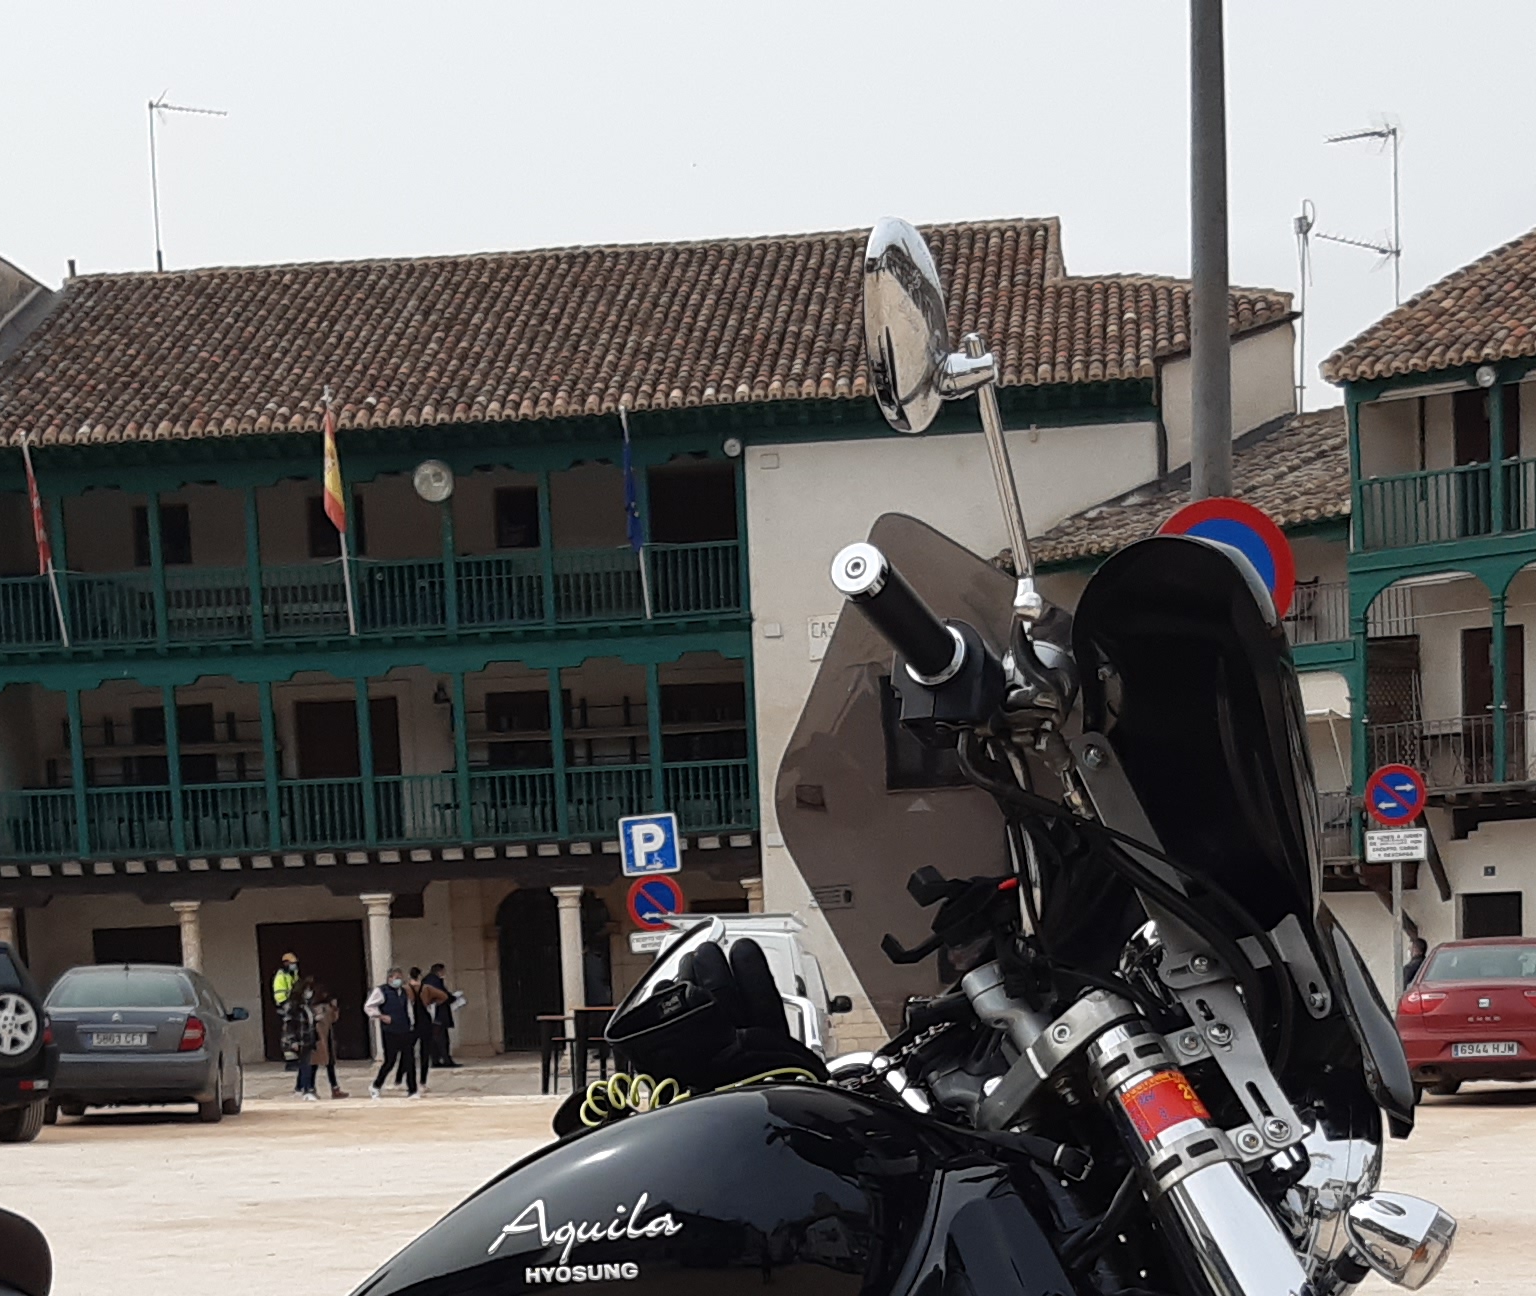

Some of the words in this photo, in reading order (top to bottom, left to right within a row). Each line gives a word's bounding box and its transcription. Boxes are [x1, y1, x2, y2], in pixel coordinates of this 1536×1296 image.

[631, 823, 665, 867] P
[1460, 1044, 1489, 1055] 6944
[1492, 1043, 1515, 1054] HJM
[487, 1192, 683, 1265] Aquila
[525, 1262, 639, 1284] HYOSUNG
